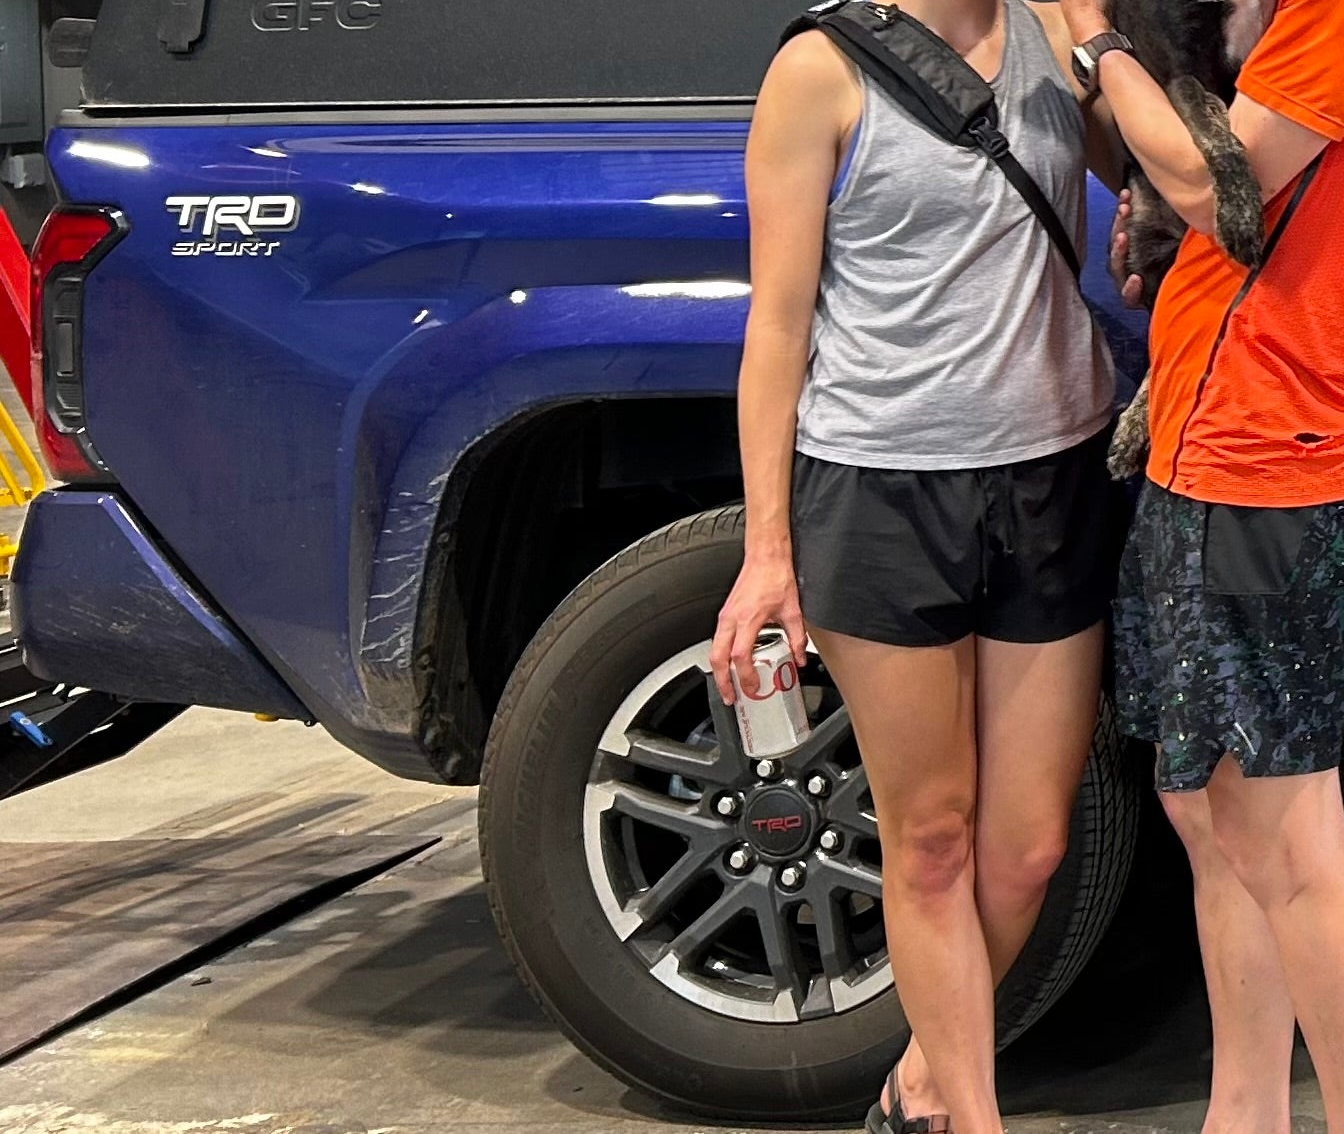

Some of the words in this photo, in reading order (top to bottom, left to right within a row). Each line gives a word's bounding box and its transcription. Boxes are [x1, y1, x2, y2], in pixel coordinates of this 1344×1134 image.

[165, 194, 297, 236] TRD
[171, 242, 280, 255] SPORT
[752, 814, 801, 834] TRD
